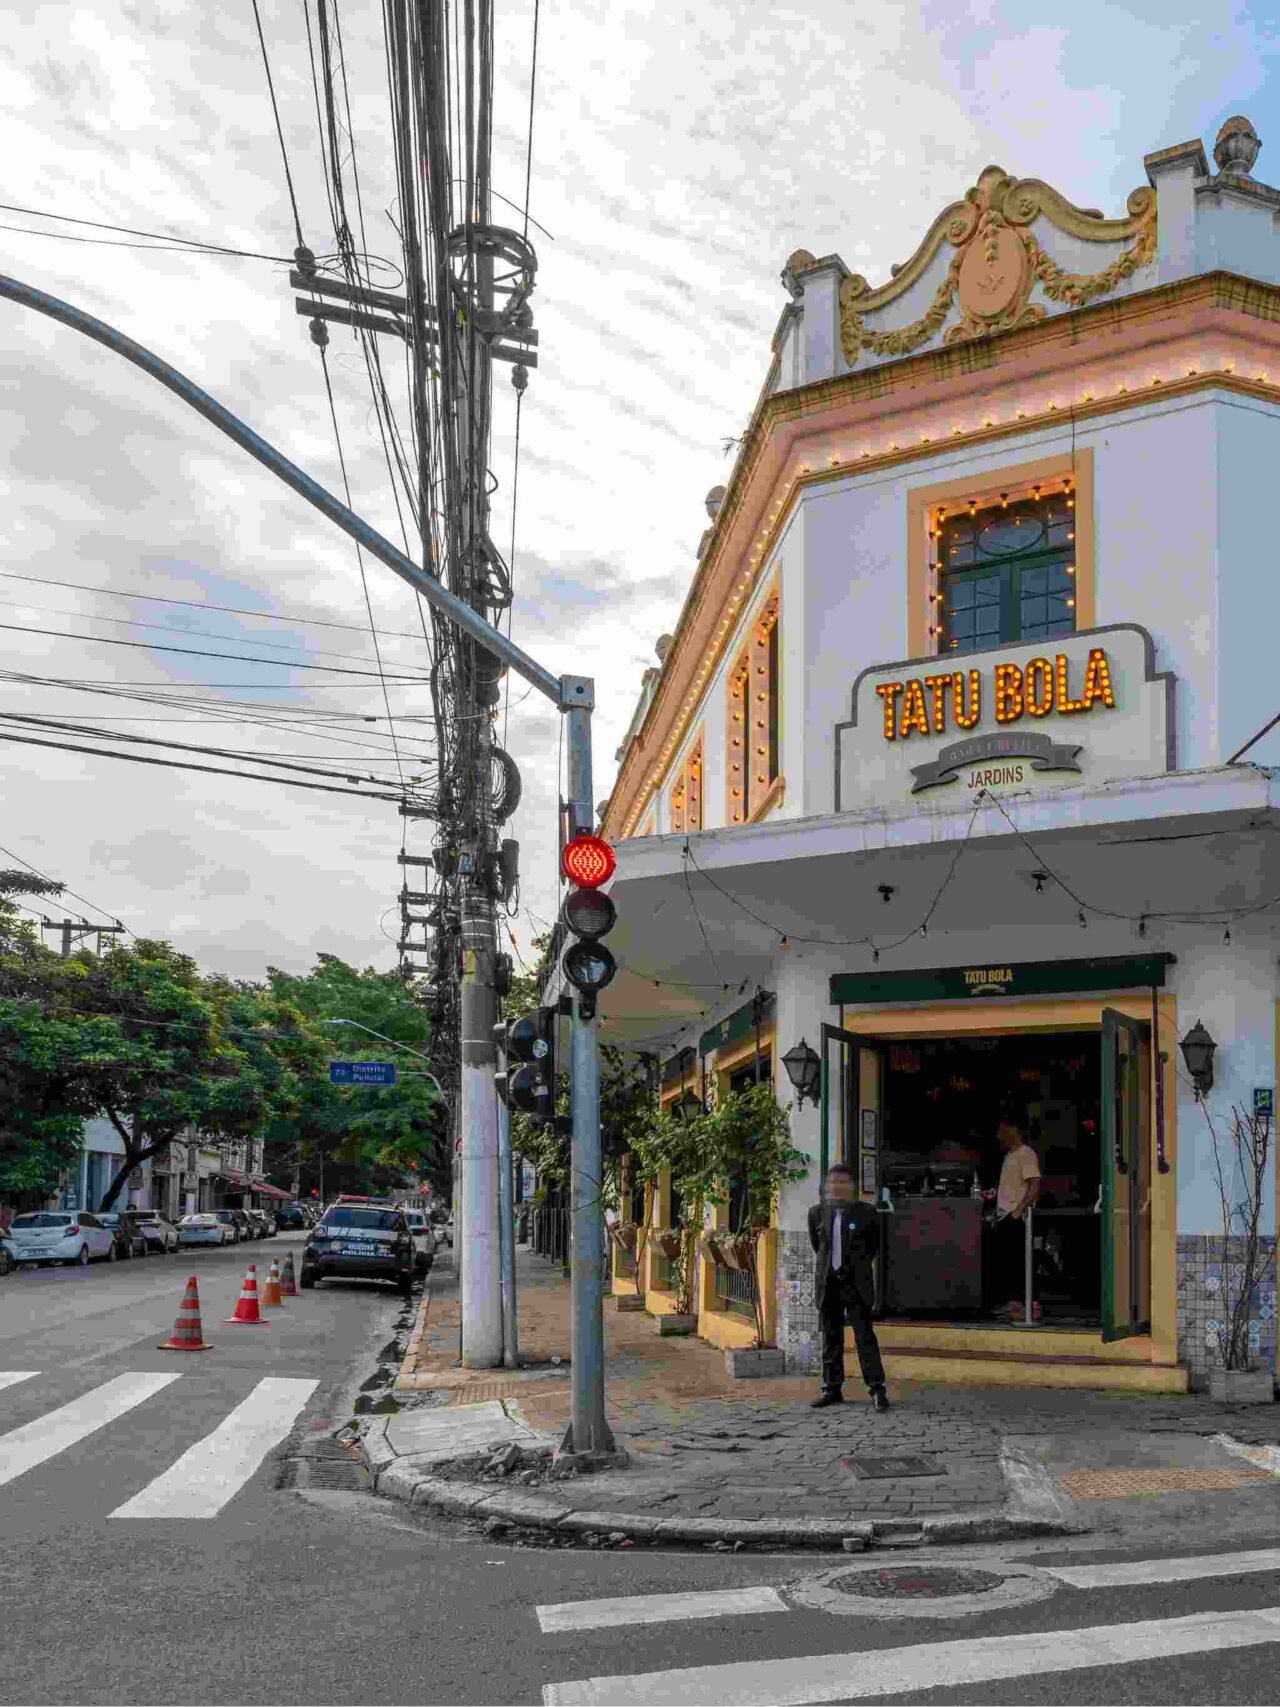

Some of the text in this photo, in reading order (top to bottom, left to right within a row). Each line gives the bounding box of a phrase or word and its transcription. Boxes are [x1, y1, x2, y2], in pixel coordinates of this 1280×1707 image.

[876, 648, 1115, 740] TATU BOLA
[968, 765, 1024, 789] JARDINS
[964, 968, 1013, 984] TATU BOLA
